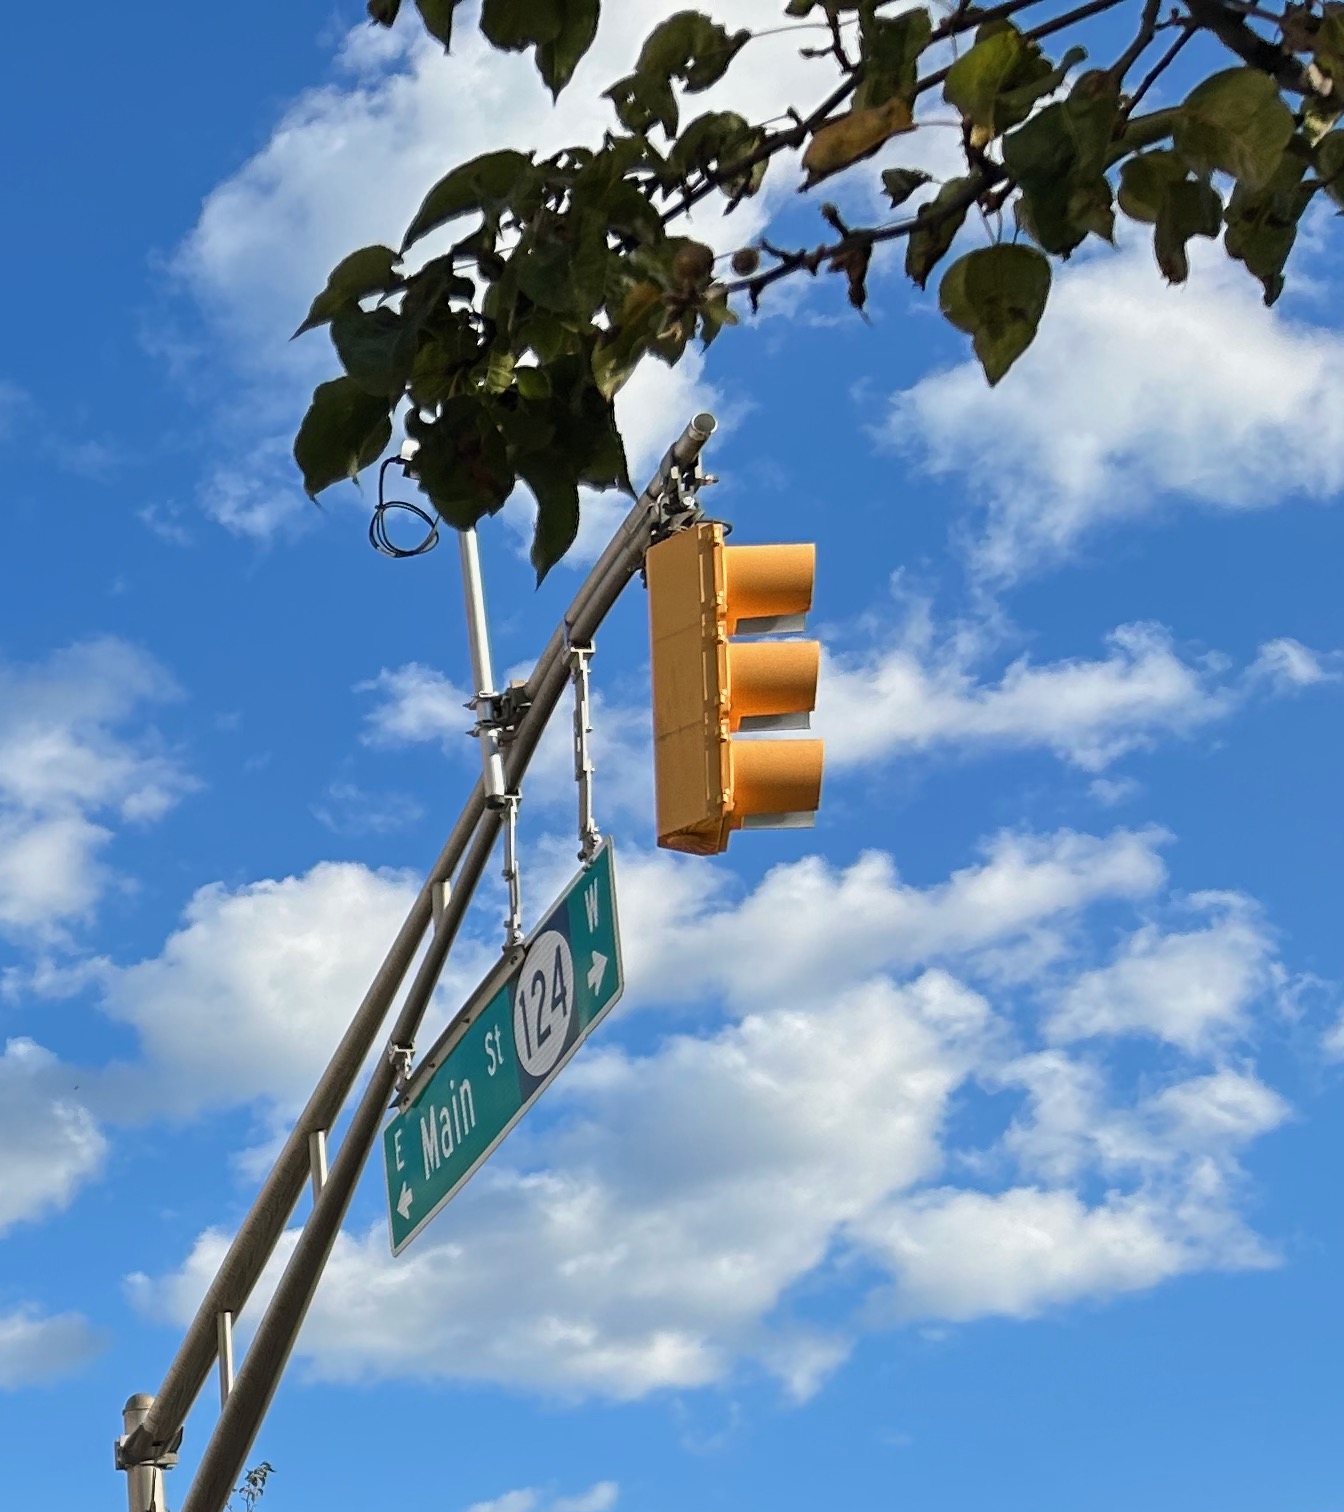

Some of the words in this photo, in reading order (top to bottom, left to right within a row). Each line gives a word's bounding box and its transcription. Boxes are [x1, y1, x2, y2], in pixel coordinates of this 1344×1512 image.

[584, 878, 600, 933] W
[518, 944, 568, 1062] 124
[419, 1077, 476, 1180] Main
[484, 1023, 505, 1077] St
[395, 1128, 405, 1172] E
